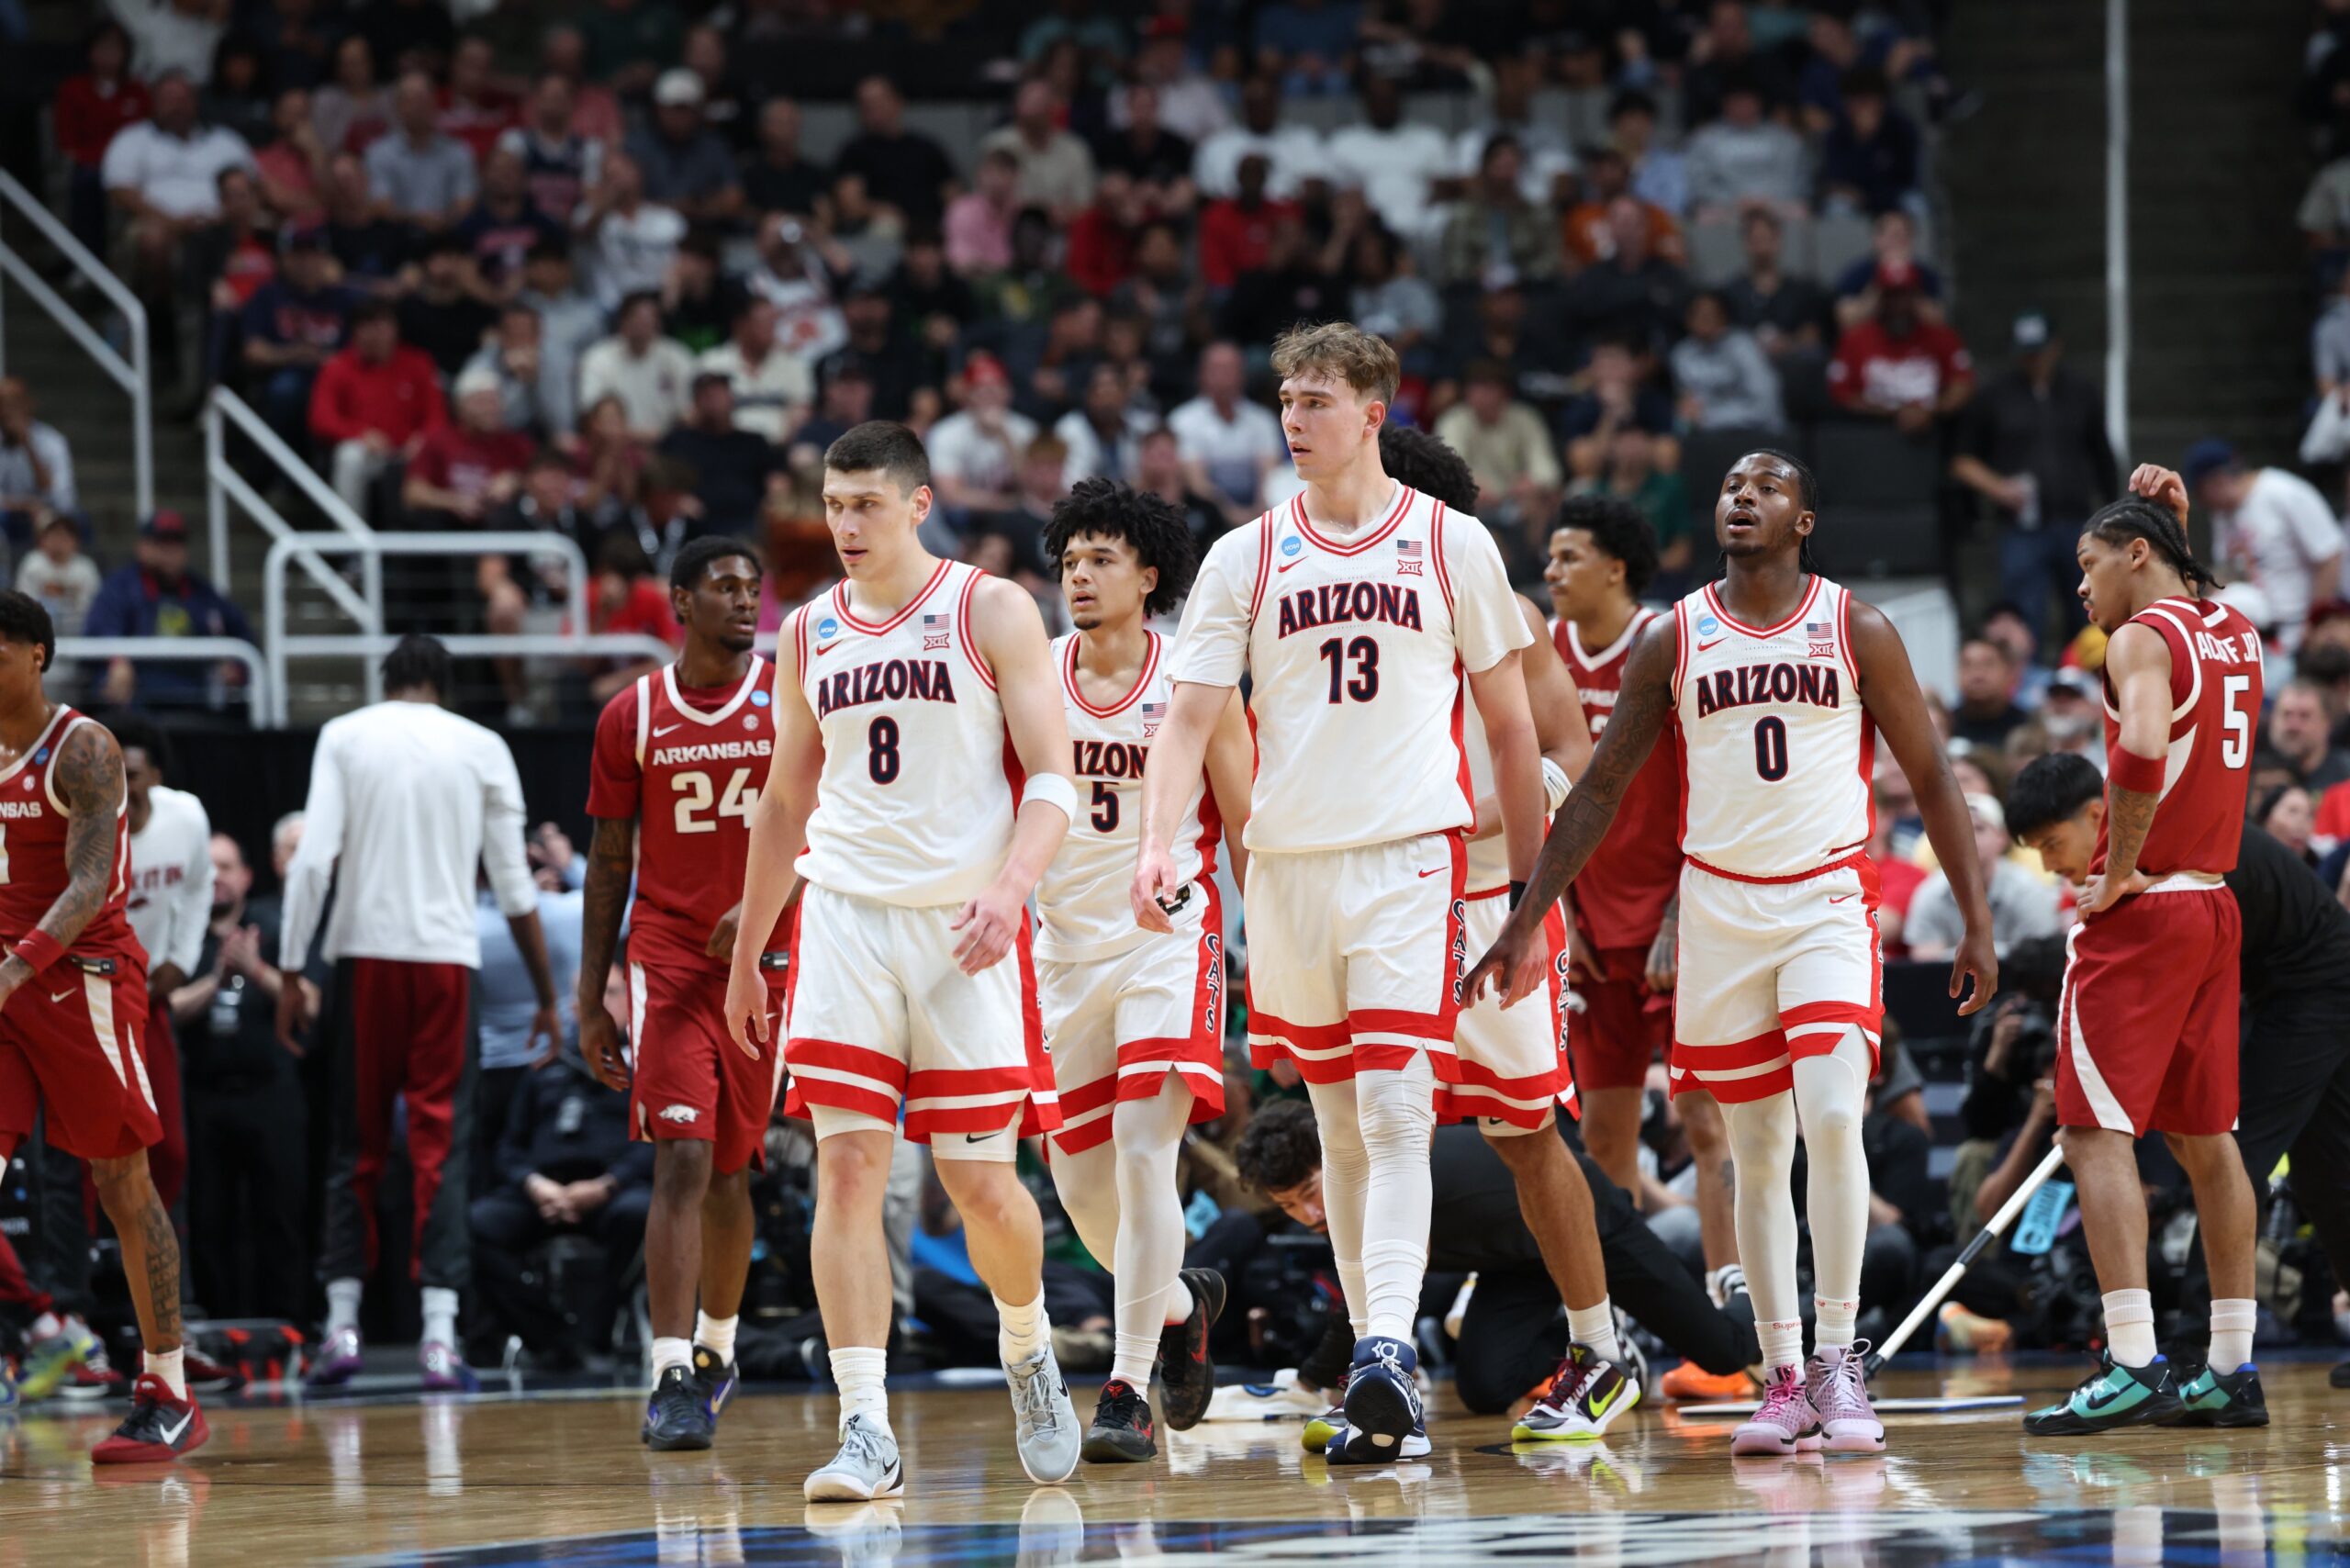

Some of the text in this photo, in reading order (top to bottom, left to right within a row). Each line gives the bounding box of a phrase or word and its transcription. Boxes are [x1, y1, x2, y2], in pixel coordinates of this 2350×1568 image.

[1278, 581, 1423, 639] ARIZONA
[818, 659, 957, 722] ARIZONA
[1319, 635, 1379, 704] 13
[1696, 663, 1840, 719] ARIZONA
[652, 739, 772, 766] ARKANSAS
[868, 715, 900, 785] 8
[1754, 716, 1788, 782] 0
[2221, 675, 2249, 769] 5
[1072, 740, 1149, 778] IZON
[0, 801, 42, 819] NSAS
[671, 767, 759, 834] 24
[1091, 780, 1120, 833] 5
[1205, 933, 1220, 1034] CATS
[1555, 948, 1570, 1051] CATS
